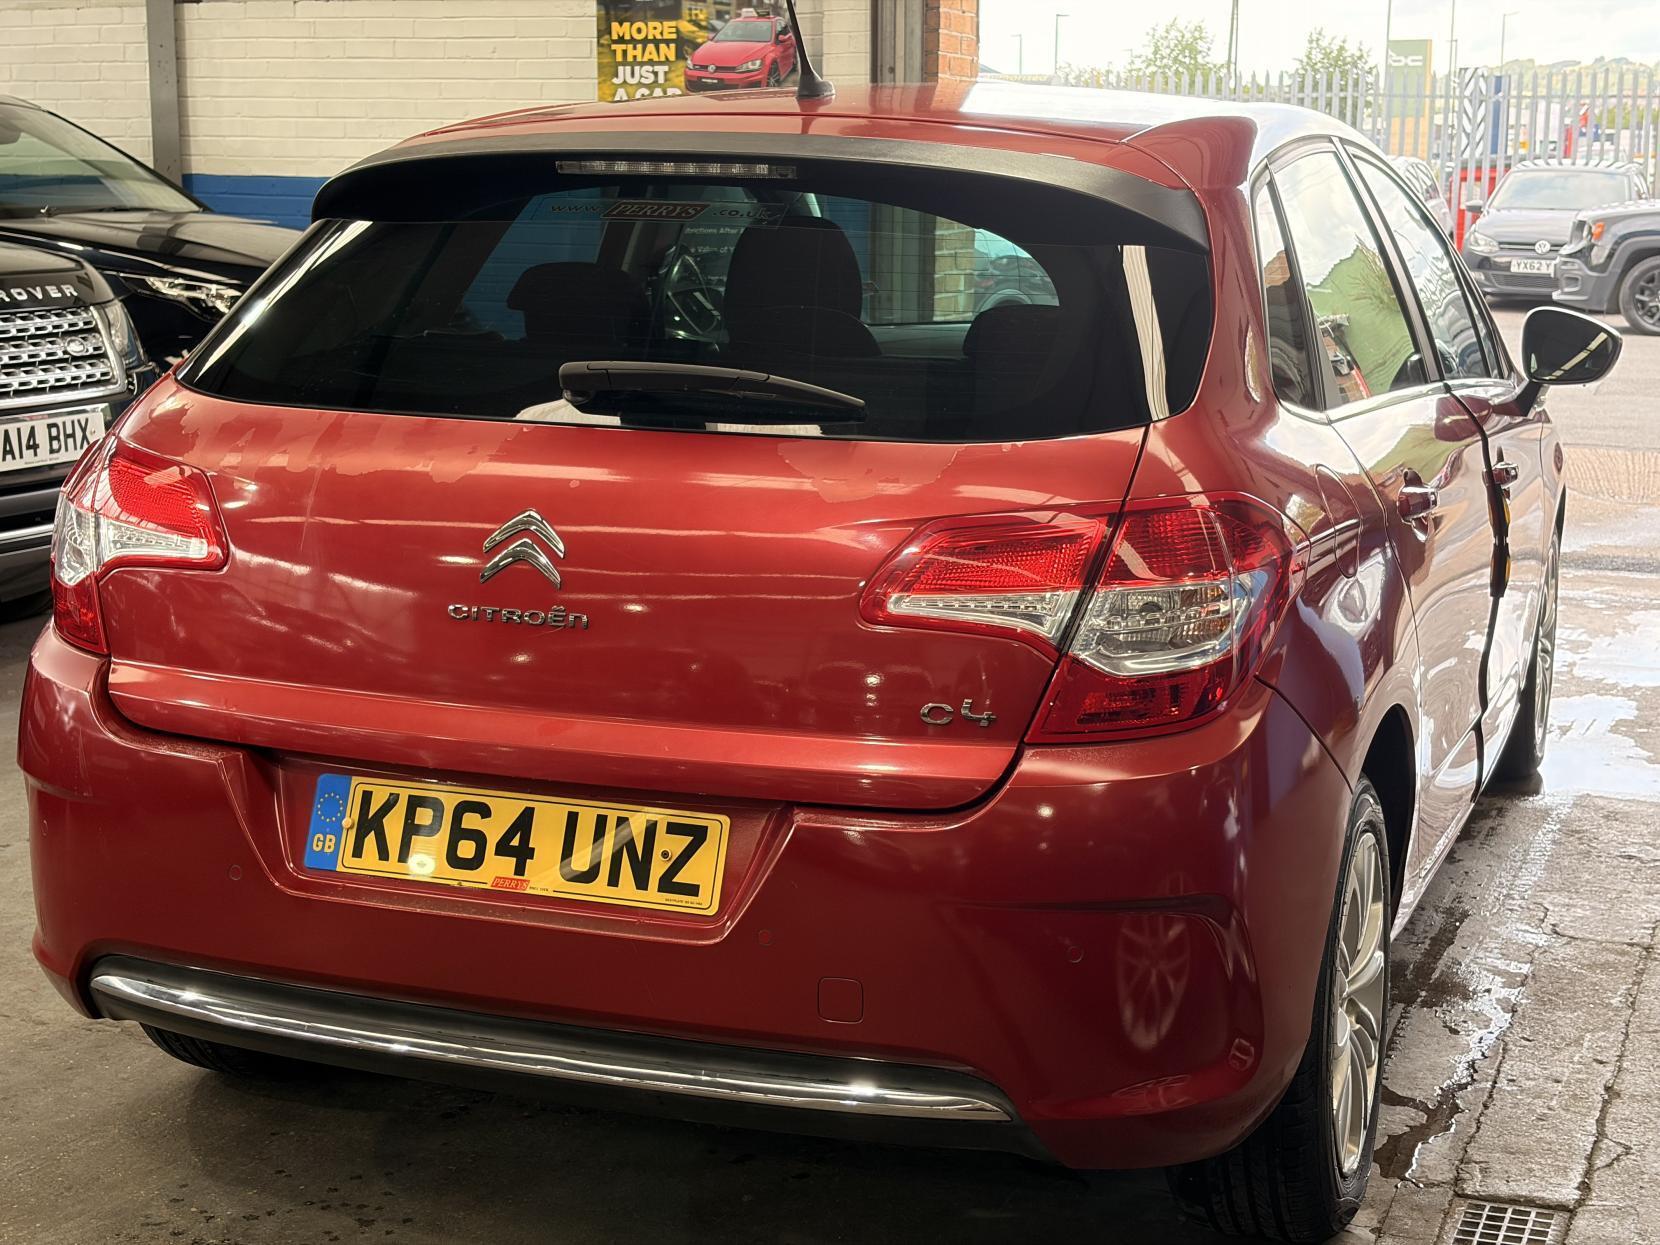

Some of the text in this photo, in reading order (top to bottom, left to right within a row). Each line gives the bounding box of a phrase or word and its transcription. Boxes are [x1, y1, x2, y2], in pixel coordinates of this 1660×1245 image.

[611, 21, 678, 40] MORE
[611, 44, 677, 62] THAN
[612, 65, 669, 84] JUST
[1516, 260, 1542, 271] YX62
[46, 417, 91, 454] BHX
[920, 698, 997, 727] C4
[311, 833, 336, 853] GB
[351, 789, 709, 897] KP64 UNZ
[492, 877, 530, 891] PERRYS
